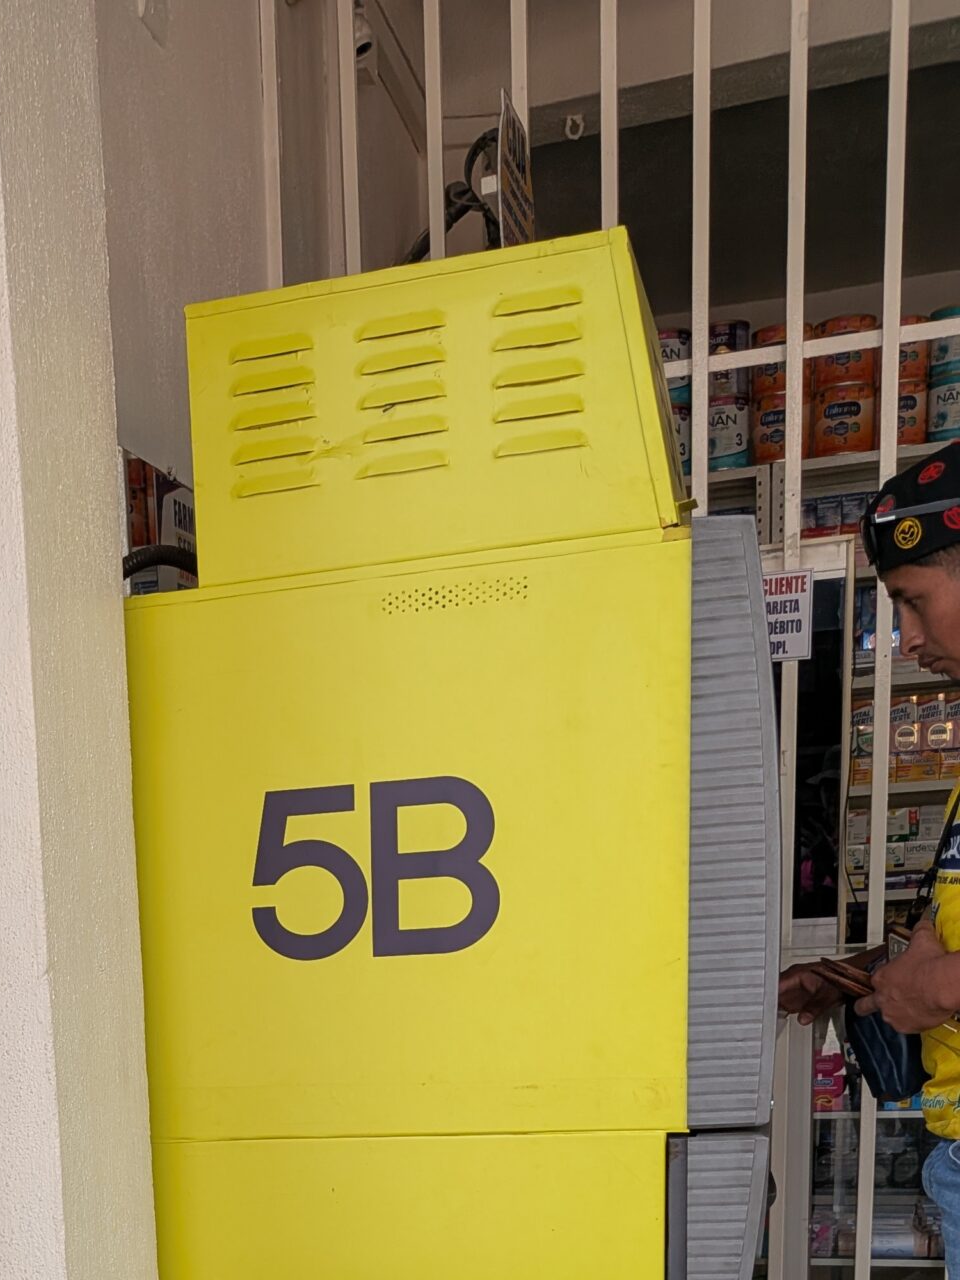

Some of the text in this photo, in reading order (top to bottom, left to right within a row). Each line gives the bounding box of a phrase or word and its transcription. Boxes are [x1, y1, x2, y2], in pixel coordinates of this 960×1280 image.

[662, 348, 681, 361] AN
[735, 433, 743, 447] 3
[679, 443, 686, 457] 3
[766, 599, 800, 615] ARJETA
[252, 776, 501, 961] 5B
